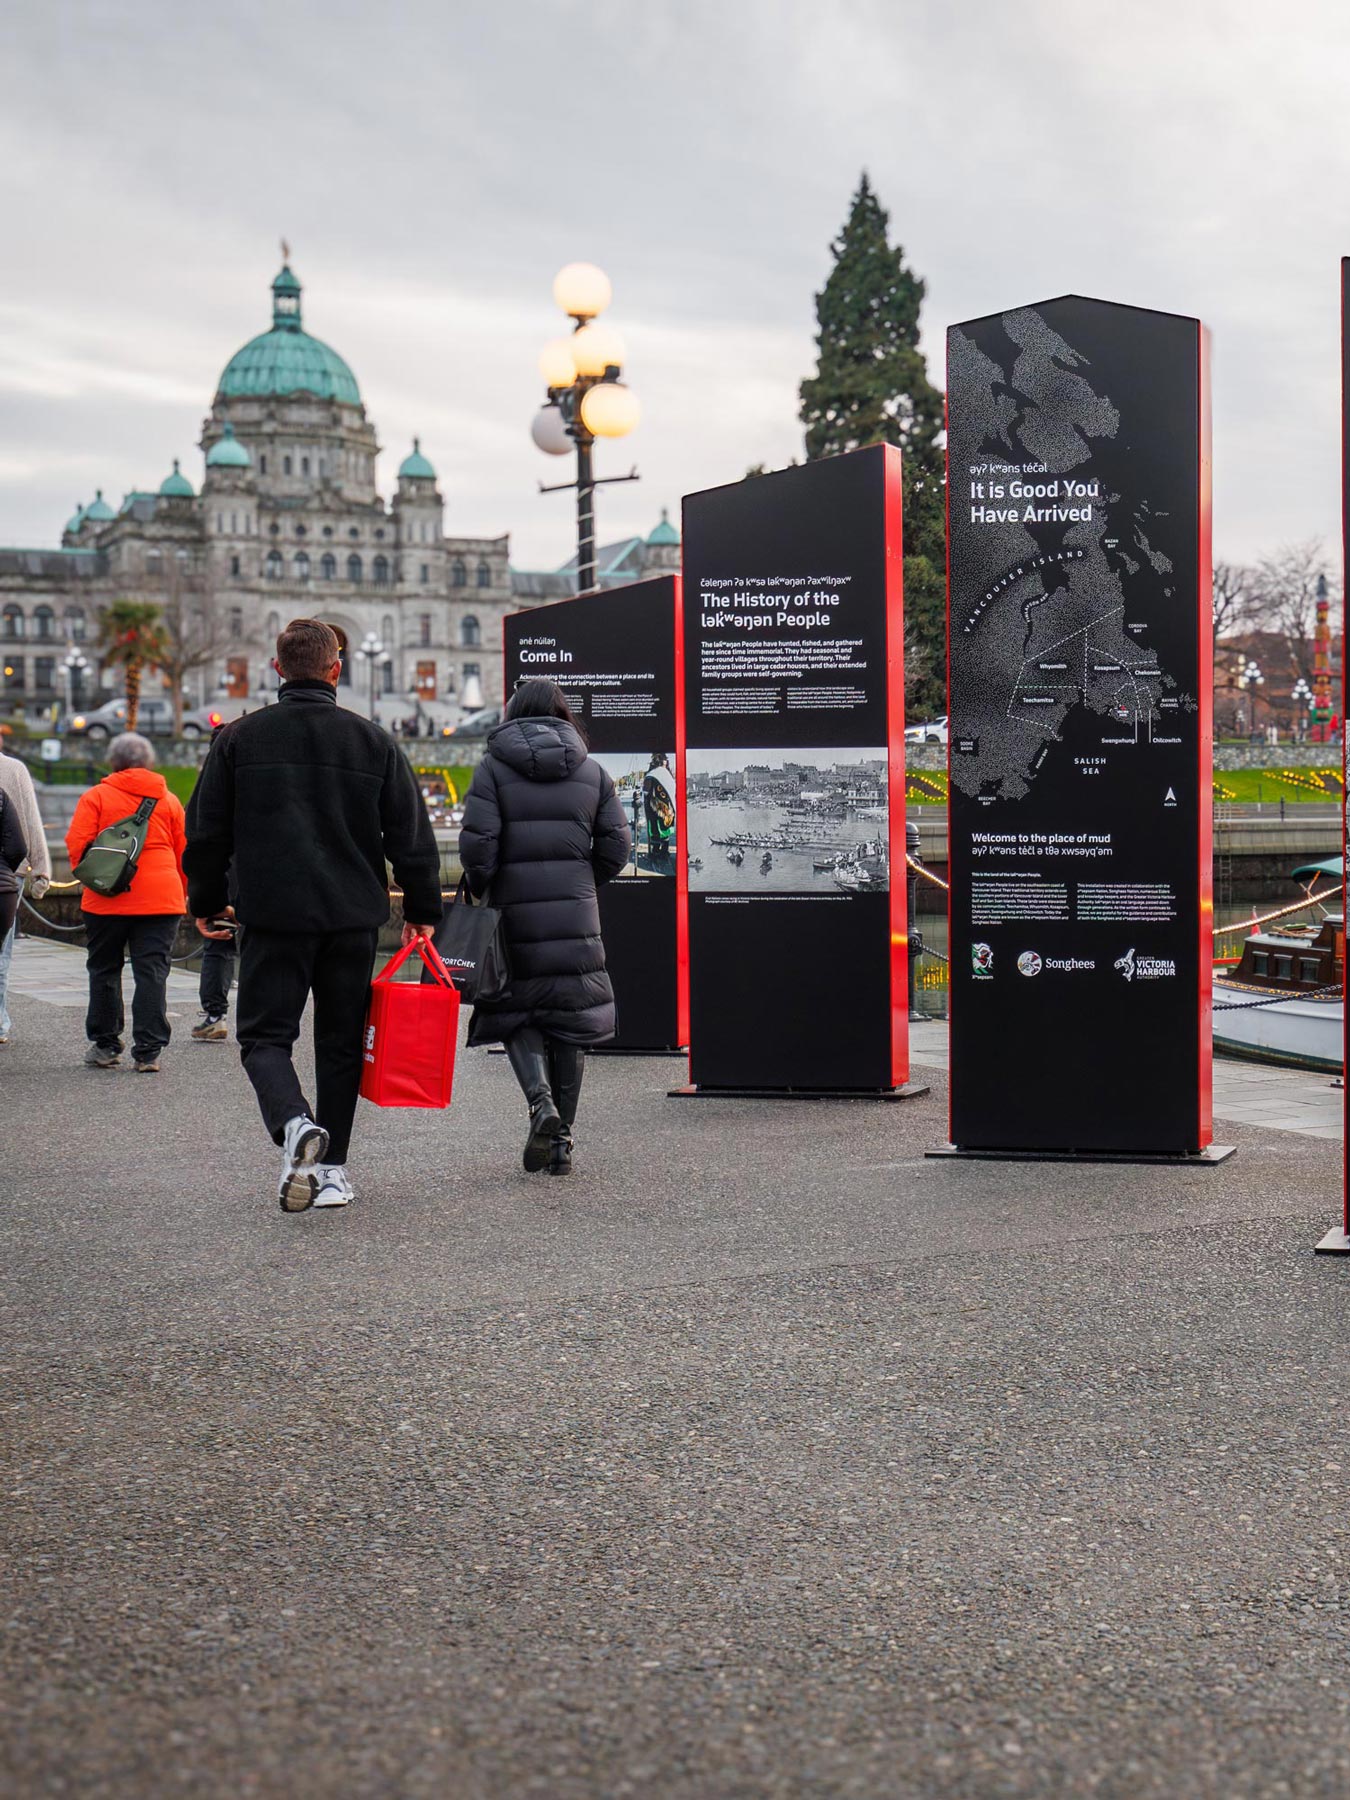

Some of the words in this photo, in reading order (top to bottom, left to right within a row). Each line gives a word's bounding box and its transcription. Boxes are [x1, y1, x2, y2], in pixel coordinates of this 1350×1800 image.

[970, 482, 986, 499] It
[989, 482, 1005, 499] is
[1009, 481, 1058, 498] Good
[1063, 480, 1099, 498] You
[971, 506, 1019, 523] Have
[1022, 505, 1092, 523] Arrived
[964, 568, 1023, 632] VANCOUVER
[1032, 550, 1083, 568] ISLAND
[700, 593, 730, 608] The
[734, 592, 791, 610] History
[794, 592, 810, 606] of
[813, 592, 840, 606] the
[777, 612, 830, 629] People
[742, 640, 762, 649] People
[802, 639, 823, 647] fished,
[835, 639, 863, 648] gathered
[519, 649, 557, 663] Come
[560, 649, 573, 662] In
[747, 647, 784, 655] immemorial.
[785, 647, 800, 656] They
[840, 646, 852, 654] and
[701, 656, 734, 664] year-round
[734, 655, 758, 664] villages
[758, 655, 793, 664] throughout
[808, 654, 835, 663] territory.
[1074, 757, 1107, 765] SALISH
[1082, 767, 1100, 775] SEA
[971, 833, 1017, 843] Welcome
[1018, 833, 1029, 843] to
[1030, 833, 1047, 843] the
[1048, 833, 1075, 845] place
[1076, 833, 1087, 843] of
[1088, 833, 1110, 843] mud
[1045, 958, 1095, 971] Songhees
[1136, 960, 1176, 968] VICTORIA
[1136, 968, 1176, 976] HARBOUR
